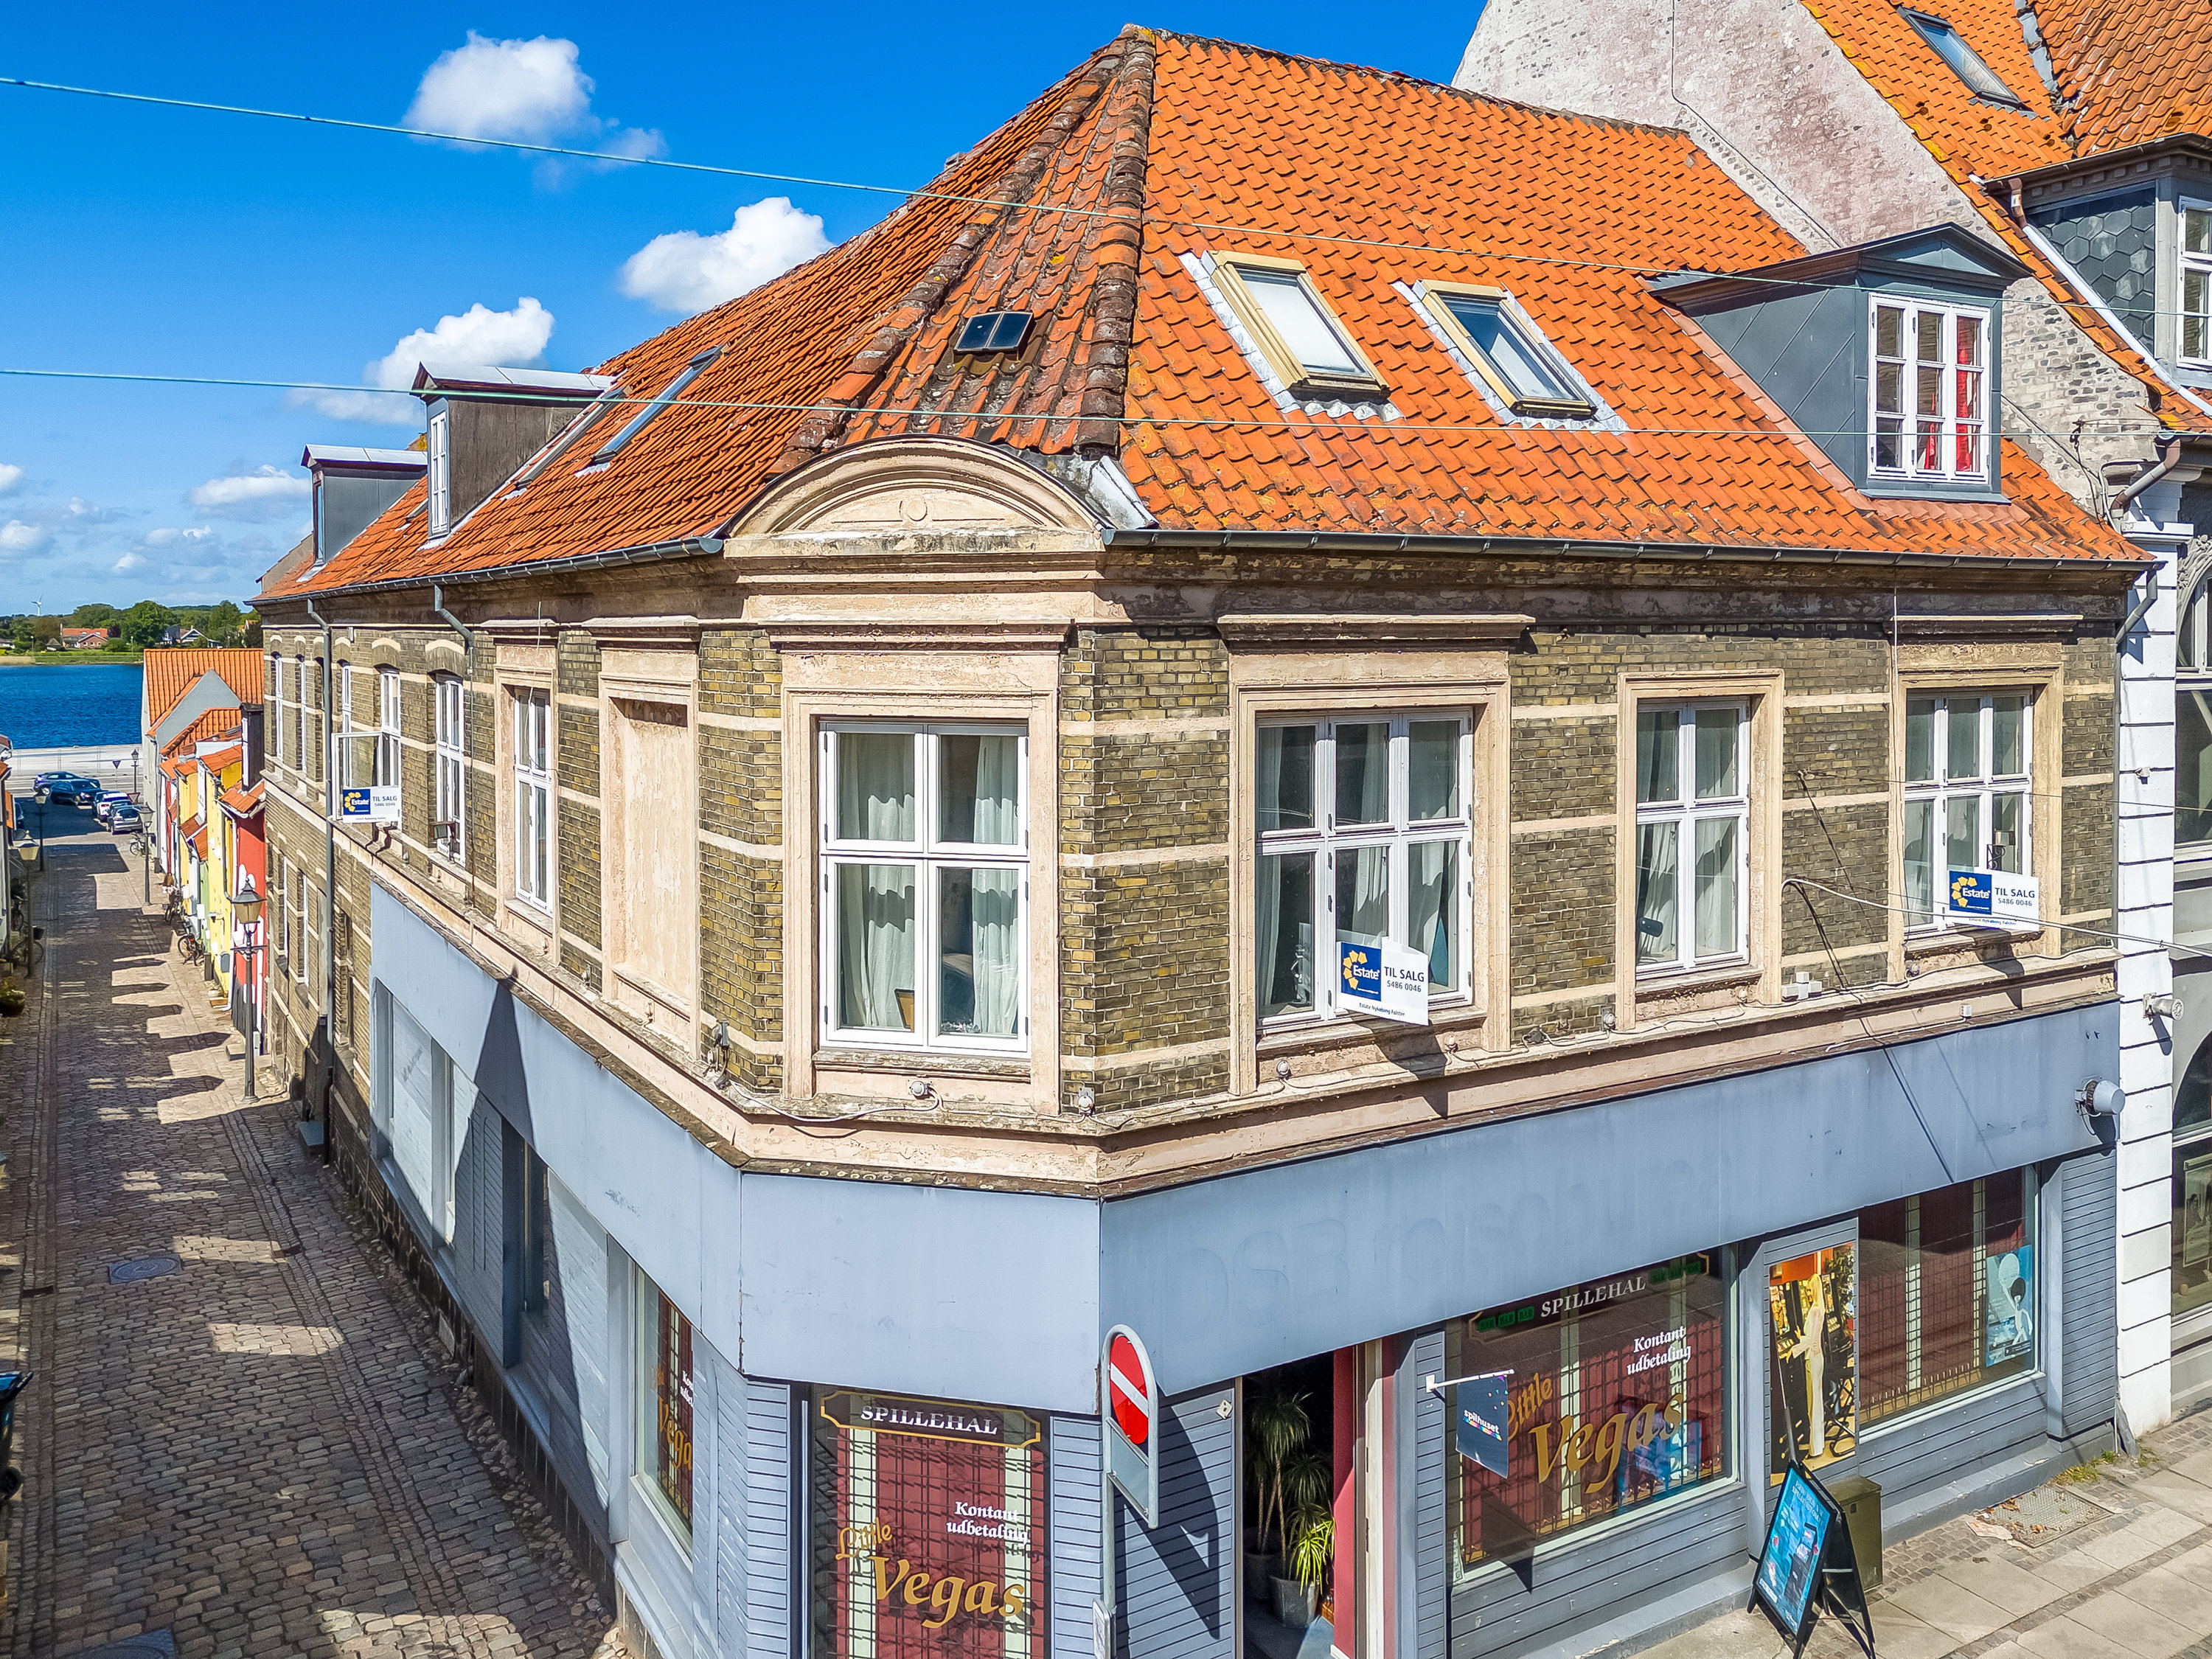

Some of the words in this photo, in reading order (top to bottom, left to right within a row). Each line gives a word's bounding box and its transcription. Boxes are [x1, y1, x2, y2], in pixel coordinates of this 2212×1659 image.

[1962, 888, 1989, 900] Estate
[1994, 887, 2008, 897] TIL
[2011, 888, 2035, 898] SALG
[1998, 897, 2014, 905] 5486
[1353, 964, 1379, 981] Estate
[1384, 966, 1397, 978] TIL
[1399, 968, 1425, 982] SALG
[1387, 980, 1403, 990] 5486
[1405, 983, 1422, 992] 0046
[1540, 1276, 1646, 1318] SPILLEHAL
[1633, 1326, 1686, 1352] Kontant
[1627, 1346, 1691, 1375] udbetaling
[860, 1405, 998, 1435] SPILLEHAL
[1464, 1409, 1500, 1434] spilhuset
[1528, 1393, 1683, 1494] Vegas
[954, 1501, 1019, 1521] Kontant
[835, 1517, 893, 1560] Little
[946, 1520, 1030, 1547] udbetaling
[869, 1555, 1025, 1629] Vegas
